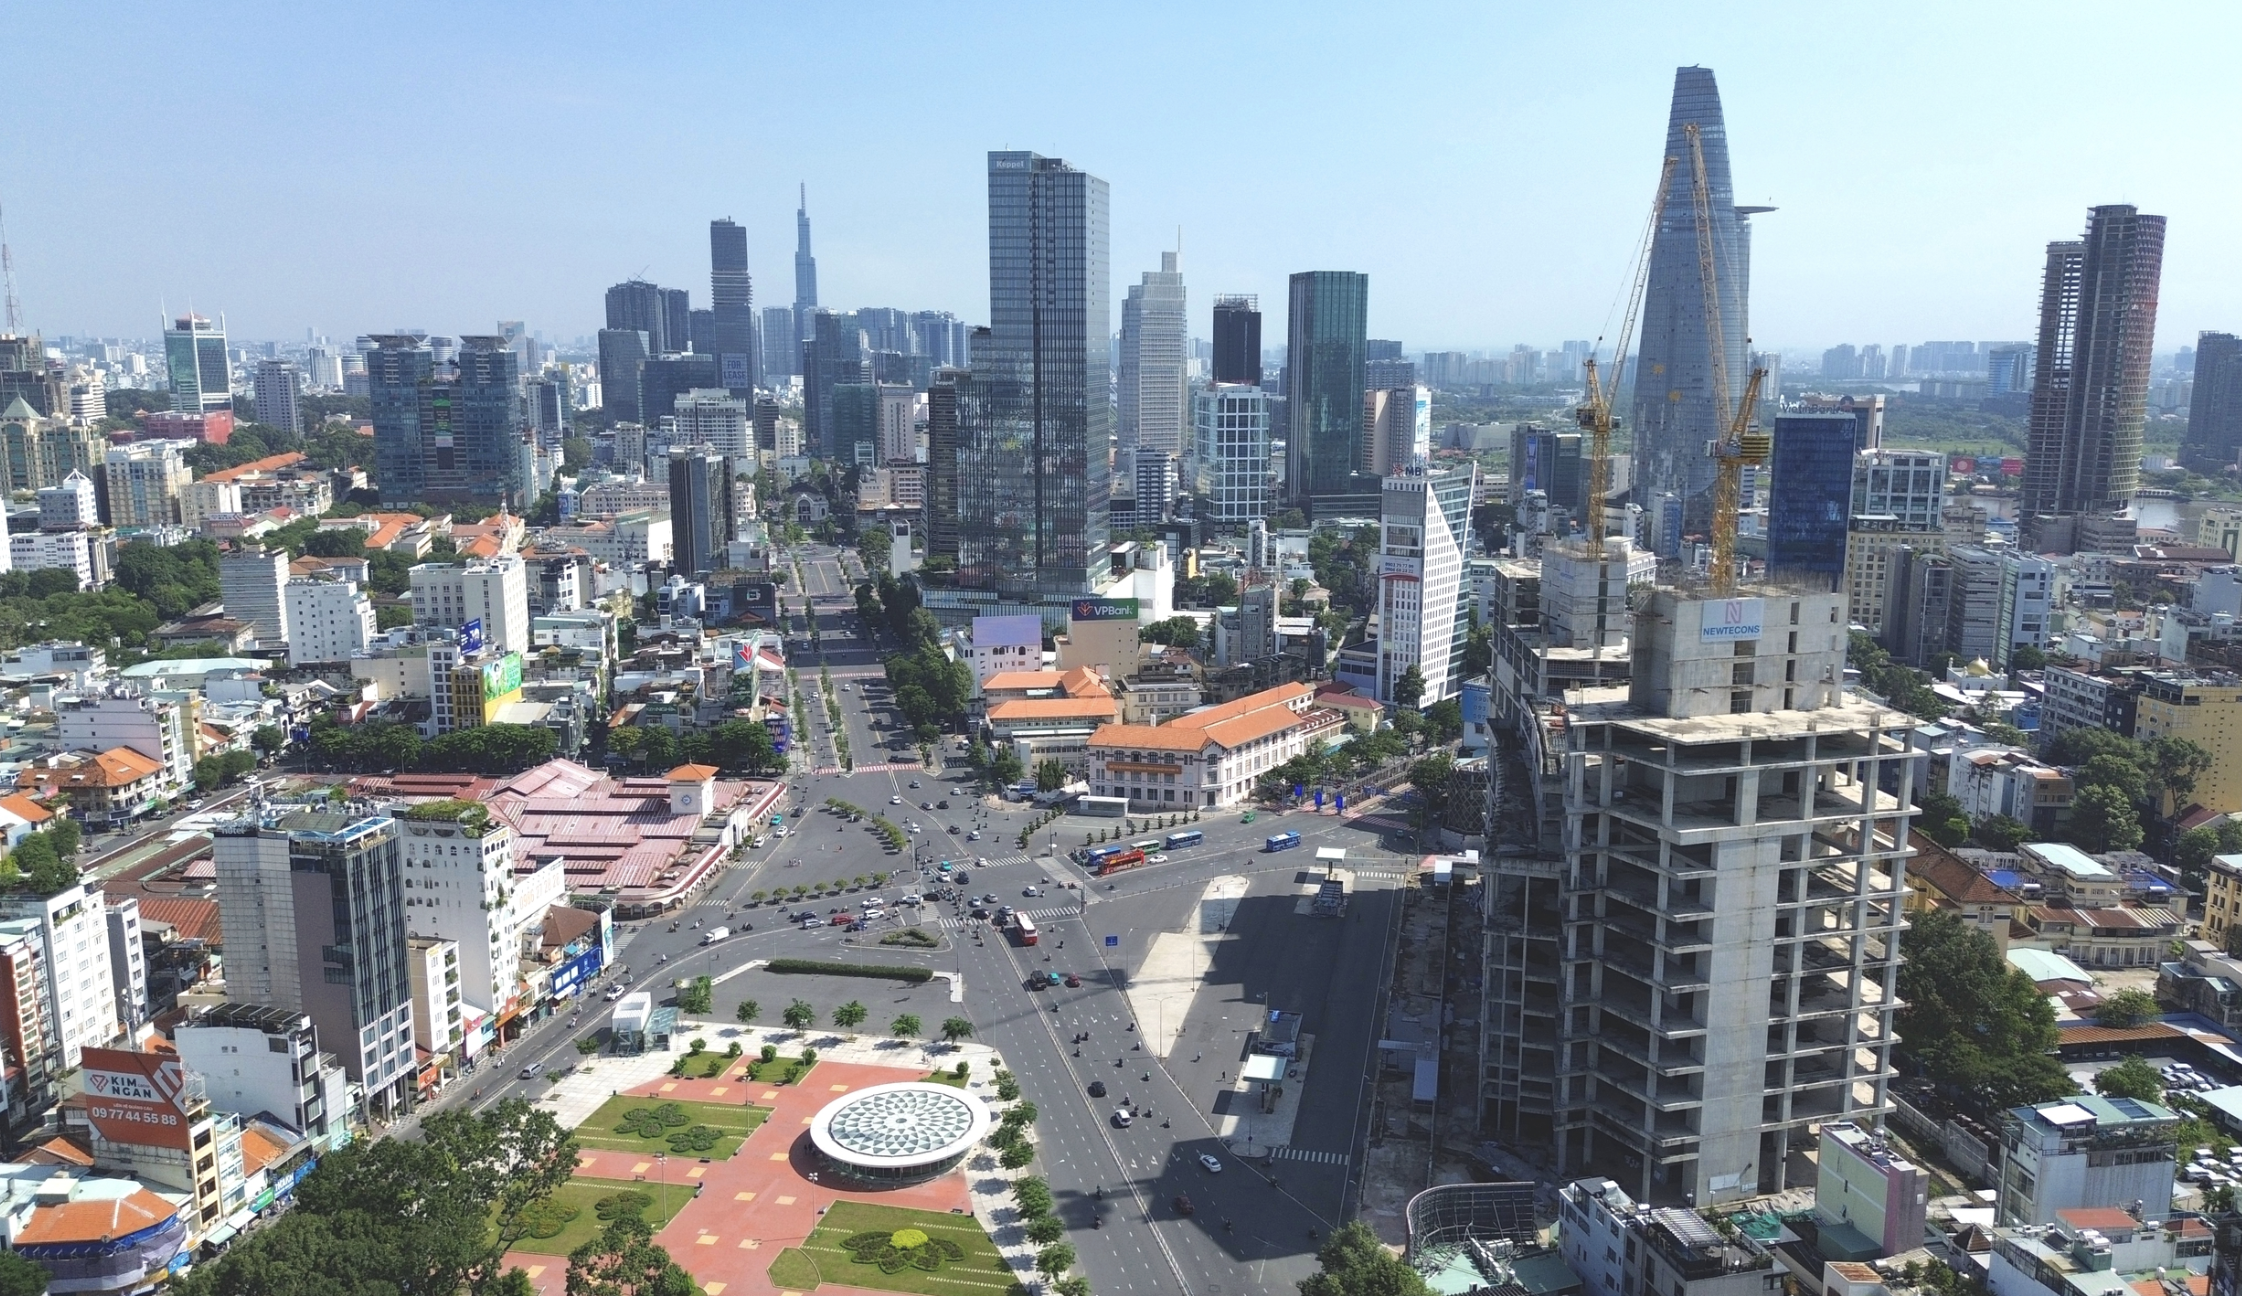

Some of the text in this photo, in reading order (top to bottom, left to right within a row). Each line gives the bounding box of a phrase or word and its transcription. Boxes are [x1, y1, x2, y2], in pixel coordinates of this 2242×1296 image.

[727, 360, 741, 369] FOR
[723, 371, 746, 379] LEASE
[1782, 403, 1841, 414] VietinBank
[1405, 466, 1422, 476] MB
[1094, 605, 1133, 616] VPBank
[1703, 625, 1760, 636] NEWTECONS
[110, 1076, 136, 1087] KIM
[112, 1086, 152, 1098] NGAN
[92, 1107, 178, 1126] 09 77 44 55 88
